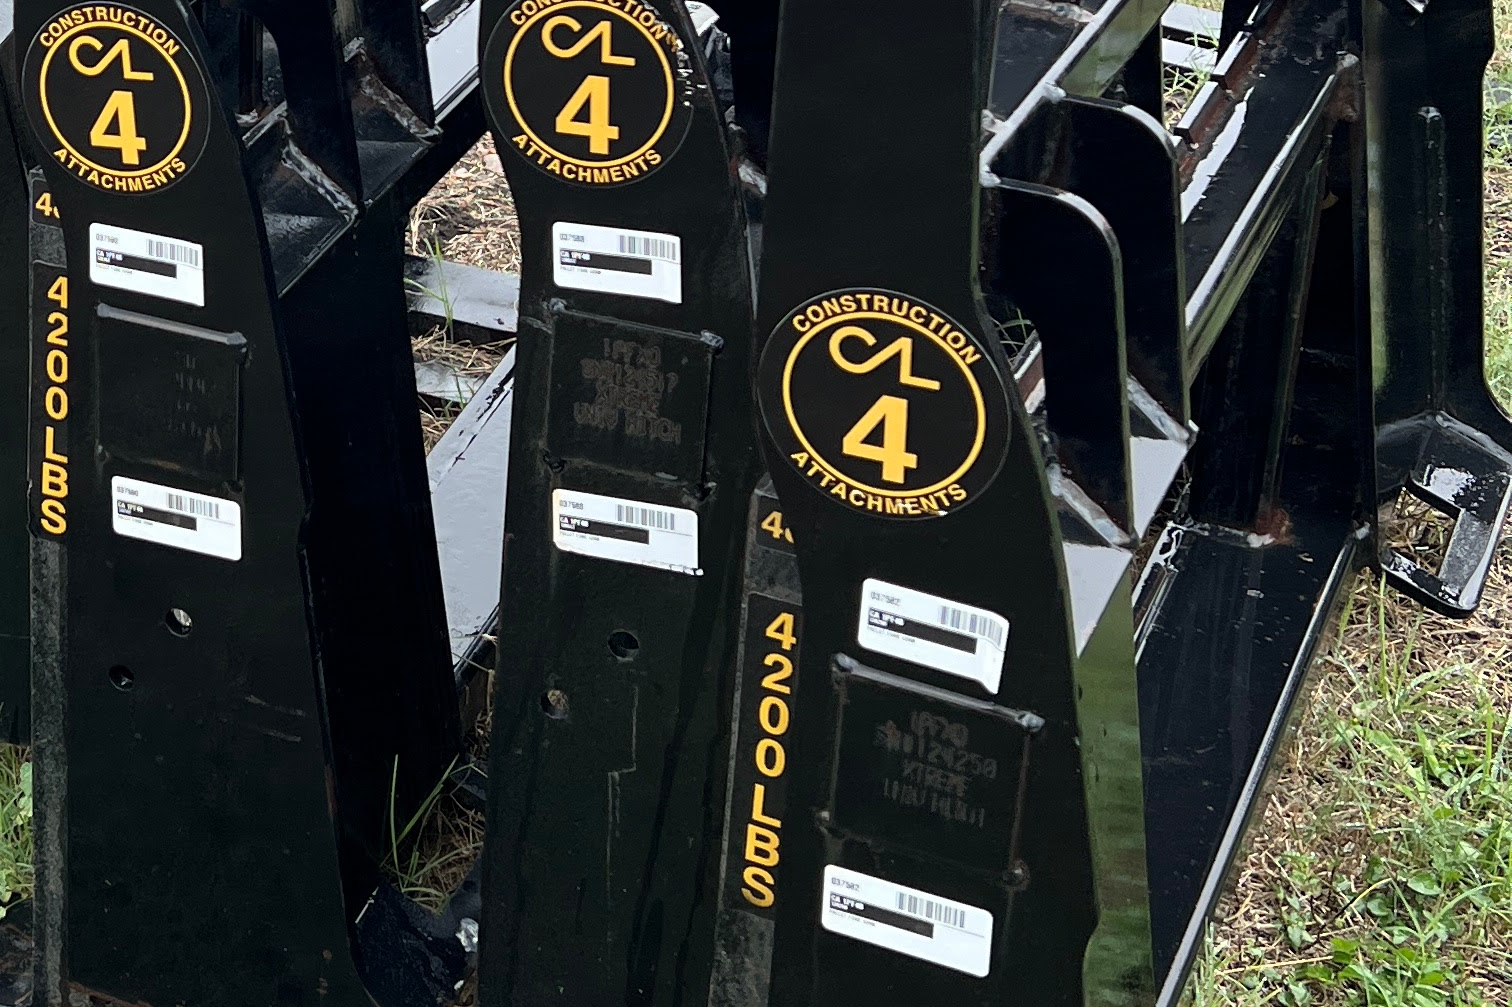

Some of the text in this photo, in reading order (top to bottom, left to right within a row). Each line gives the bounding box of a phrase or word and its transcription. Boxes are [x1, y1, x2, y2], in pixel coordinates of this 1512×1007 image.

[39, 6, 180, 56] CONSTRUCTION
[90, 89, 147, 166] 4
[555, 74, 620, 156] 4
[53, 147, 186, 192] ATTACHMENTS
[512, 134, 663, 184] ATTACHMENTS
[35, 192, 60, 219] 4
[791, 293, 982, 366] CONSTRUCTION
[842, 394, 918, 485] 4
[790, 451, 968, 515] ATTACHMENTS
[761, 510, 795, 544] 4
